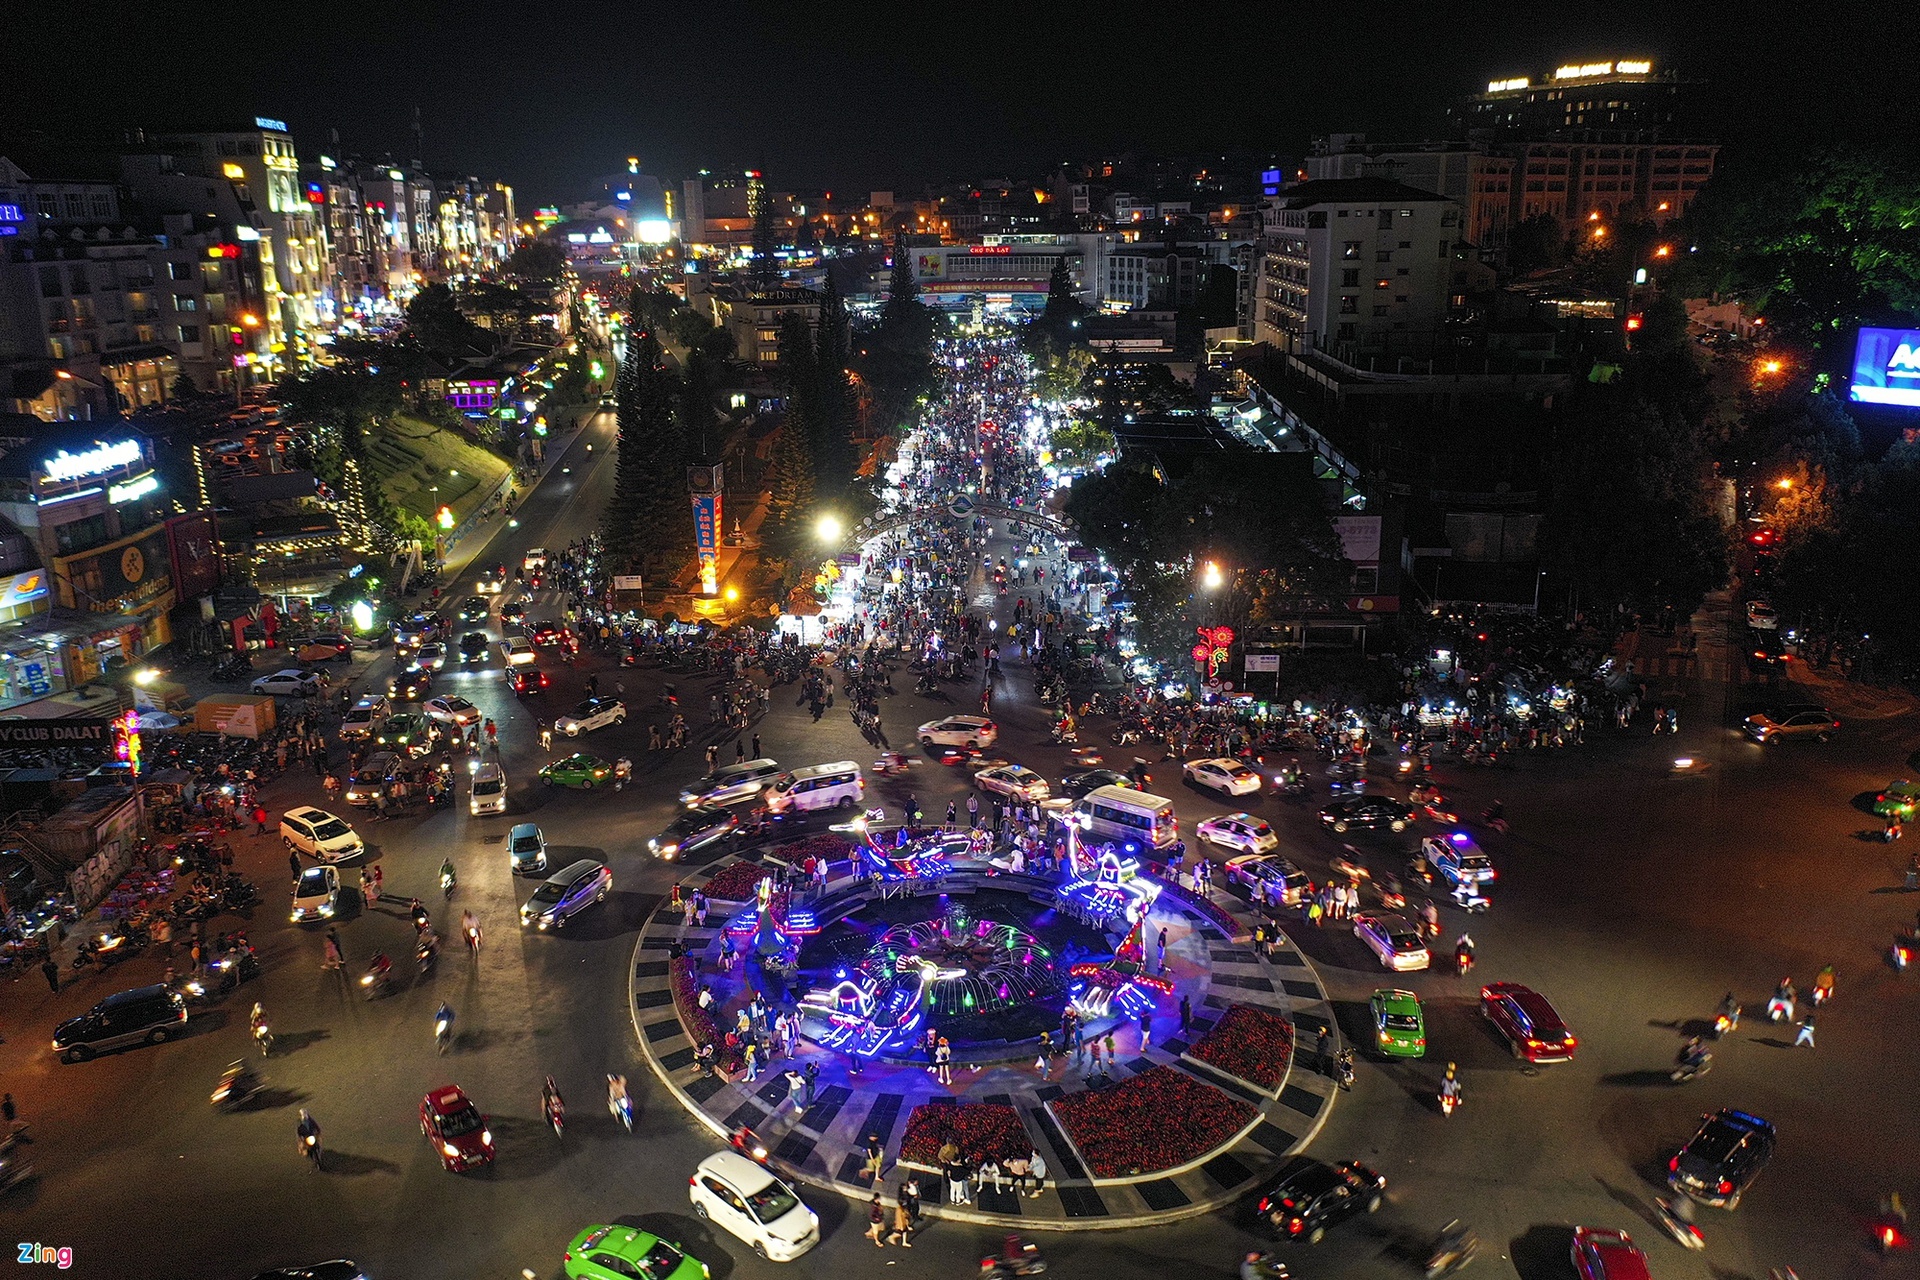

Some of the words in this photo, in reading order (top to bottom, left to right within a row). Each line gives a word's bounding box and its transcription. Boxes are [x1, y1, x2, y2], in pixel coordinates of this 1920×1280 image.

[969, 246, 984, 254] CHỢ
[776, 290, 813, 300] DREAM
[53, 725, 103, 740] DALAT
